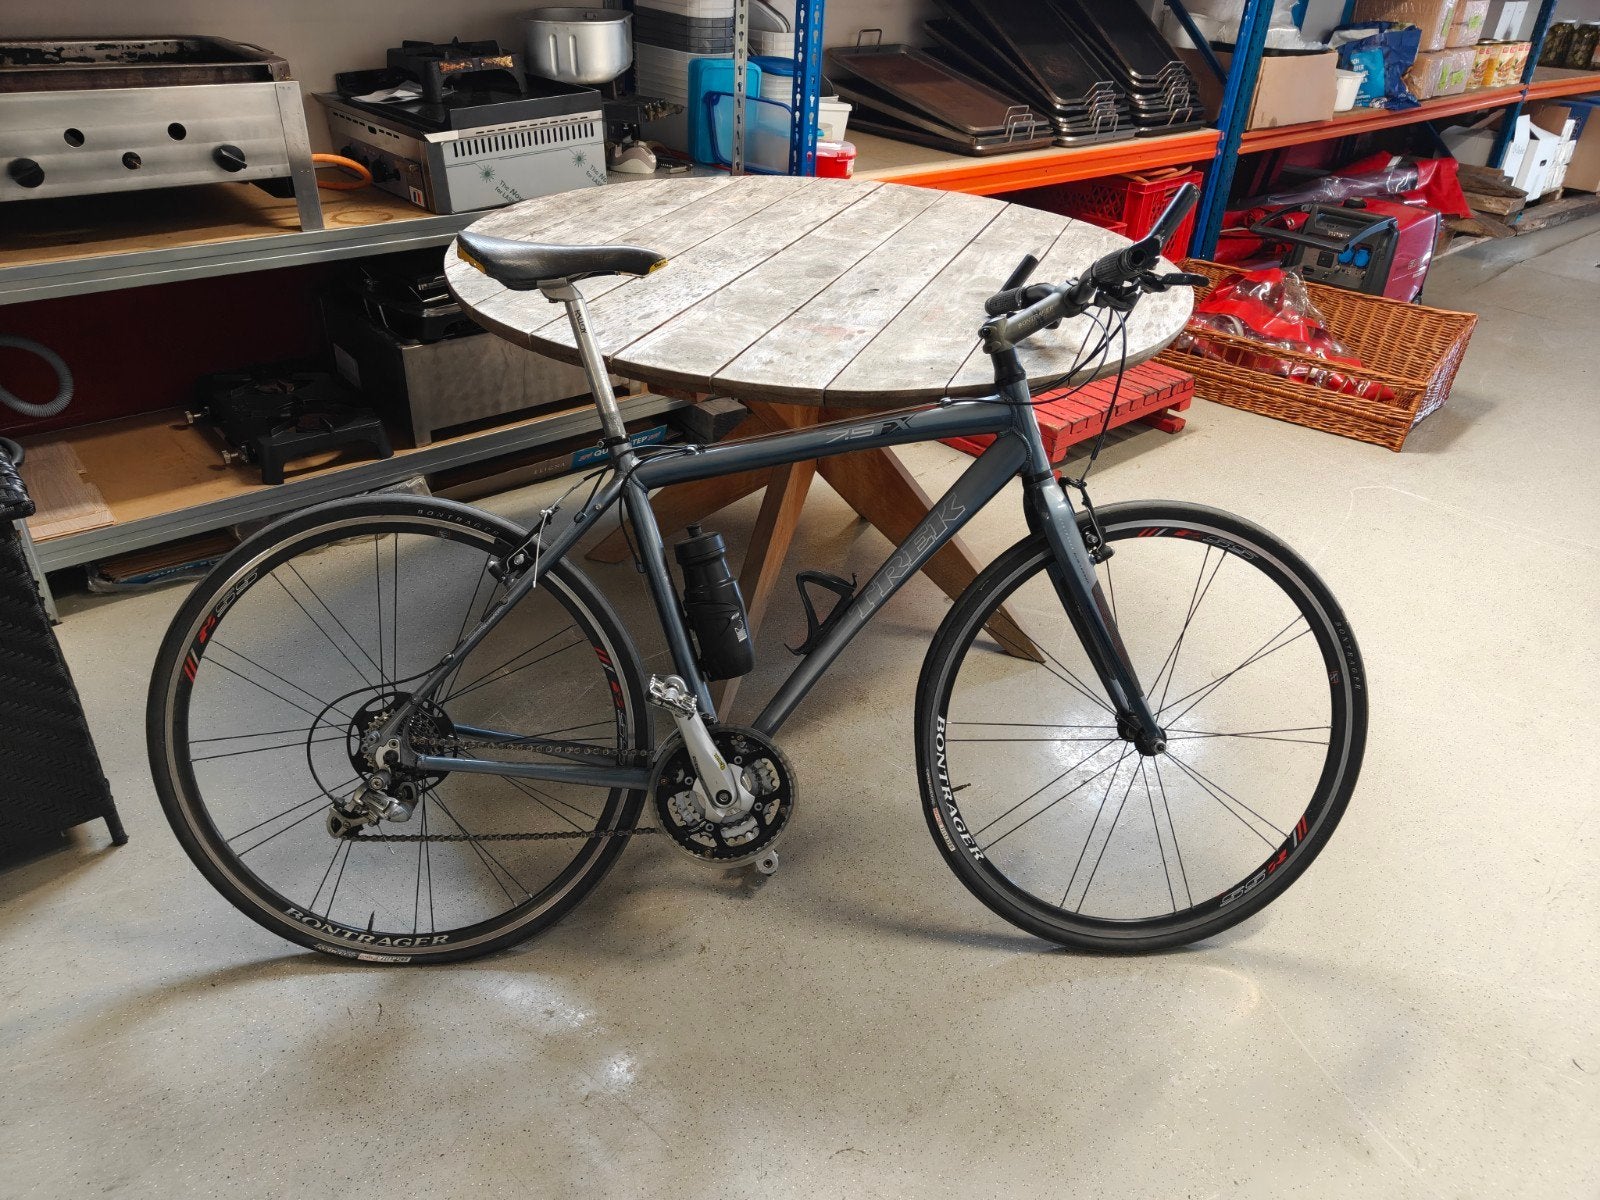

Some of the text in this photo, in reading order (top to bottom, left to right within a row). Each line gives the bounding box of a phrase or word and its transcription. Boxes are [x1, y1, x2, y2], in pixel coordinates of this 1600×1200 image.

[417, 509, 500, 535] BONTRAGER
[848, 492, 966, 619] TREK
[936, 714, 985, 861] BONTRAGER
[285, 907, 449, 948] BONTRAGER
